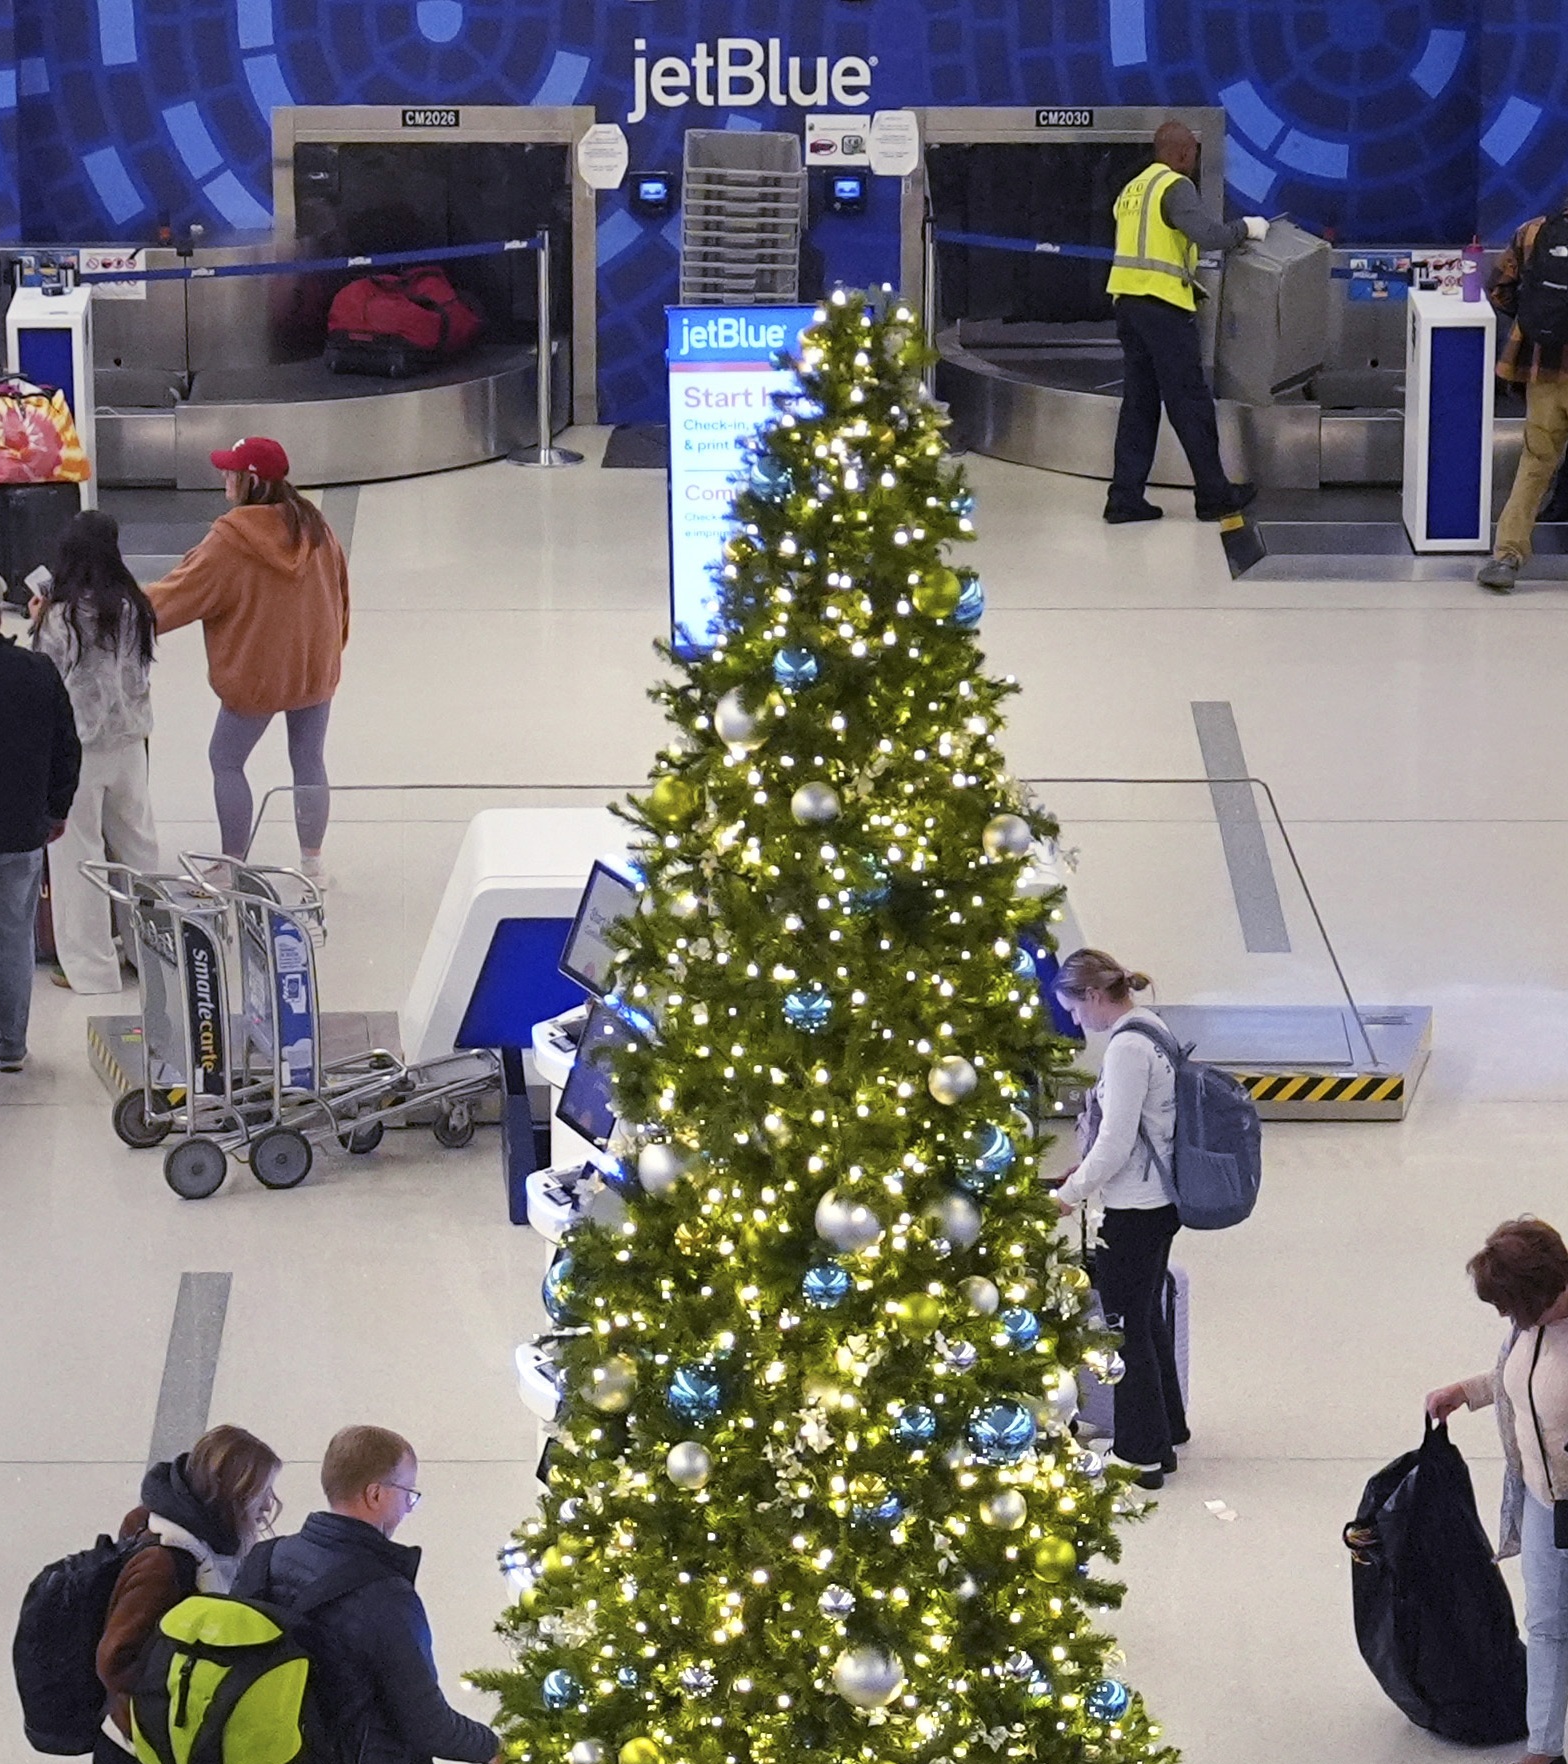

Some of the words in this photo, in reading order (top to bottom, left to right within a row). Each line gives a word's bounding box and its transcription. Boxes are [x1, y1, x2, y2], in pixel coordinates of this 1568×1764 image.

[405, 111, 456, 126] CM2026
[1039, 111, 1090, 125] CM2030
[680, 318, 786, 356] jetBlue
[684, 386, 753, 408] Start
[683, 419, 750, 433] Check-in,
[684, 440, 693, 451] &
[697, 439, 730, 454] print
